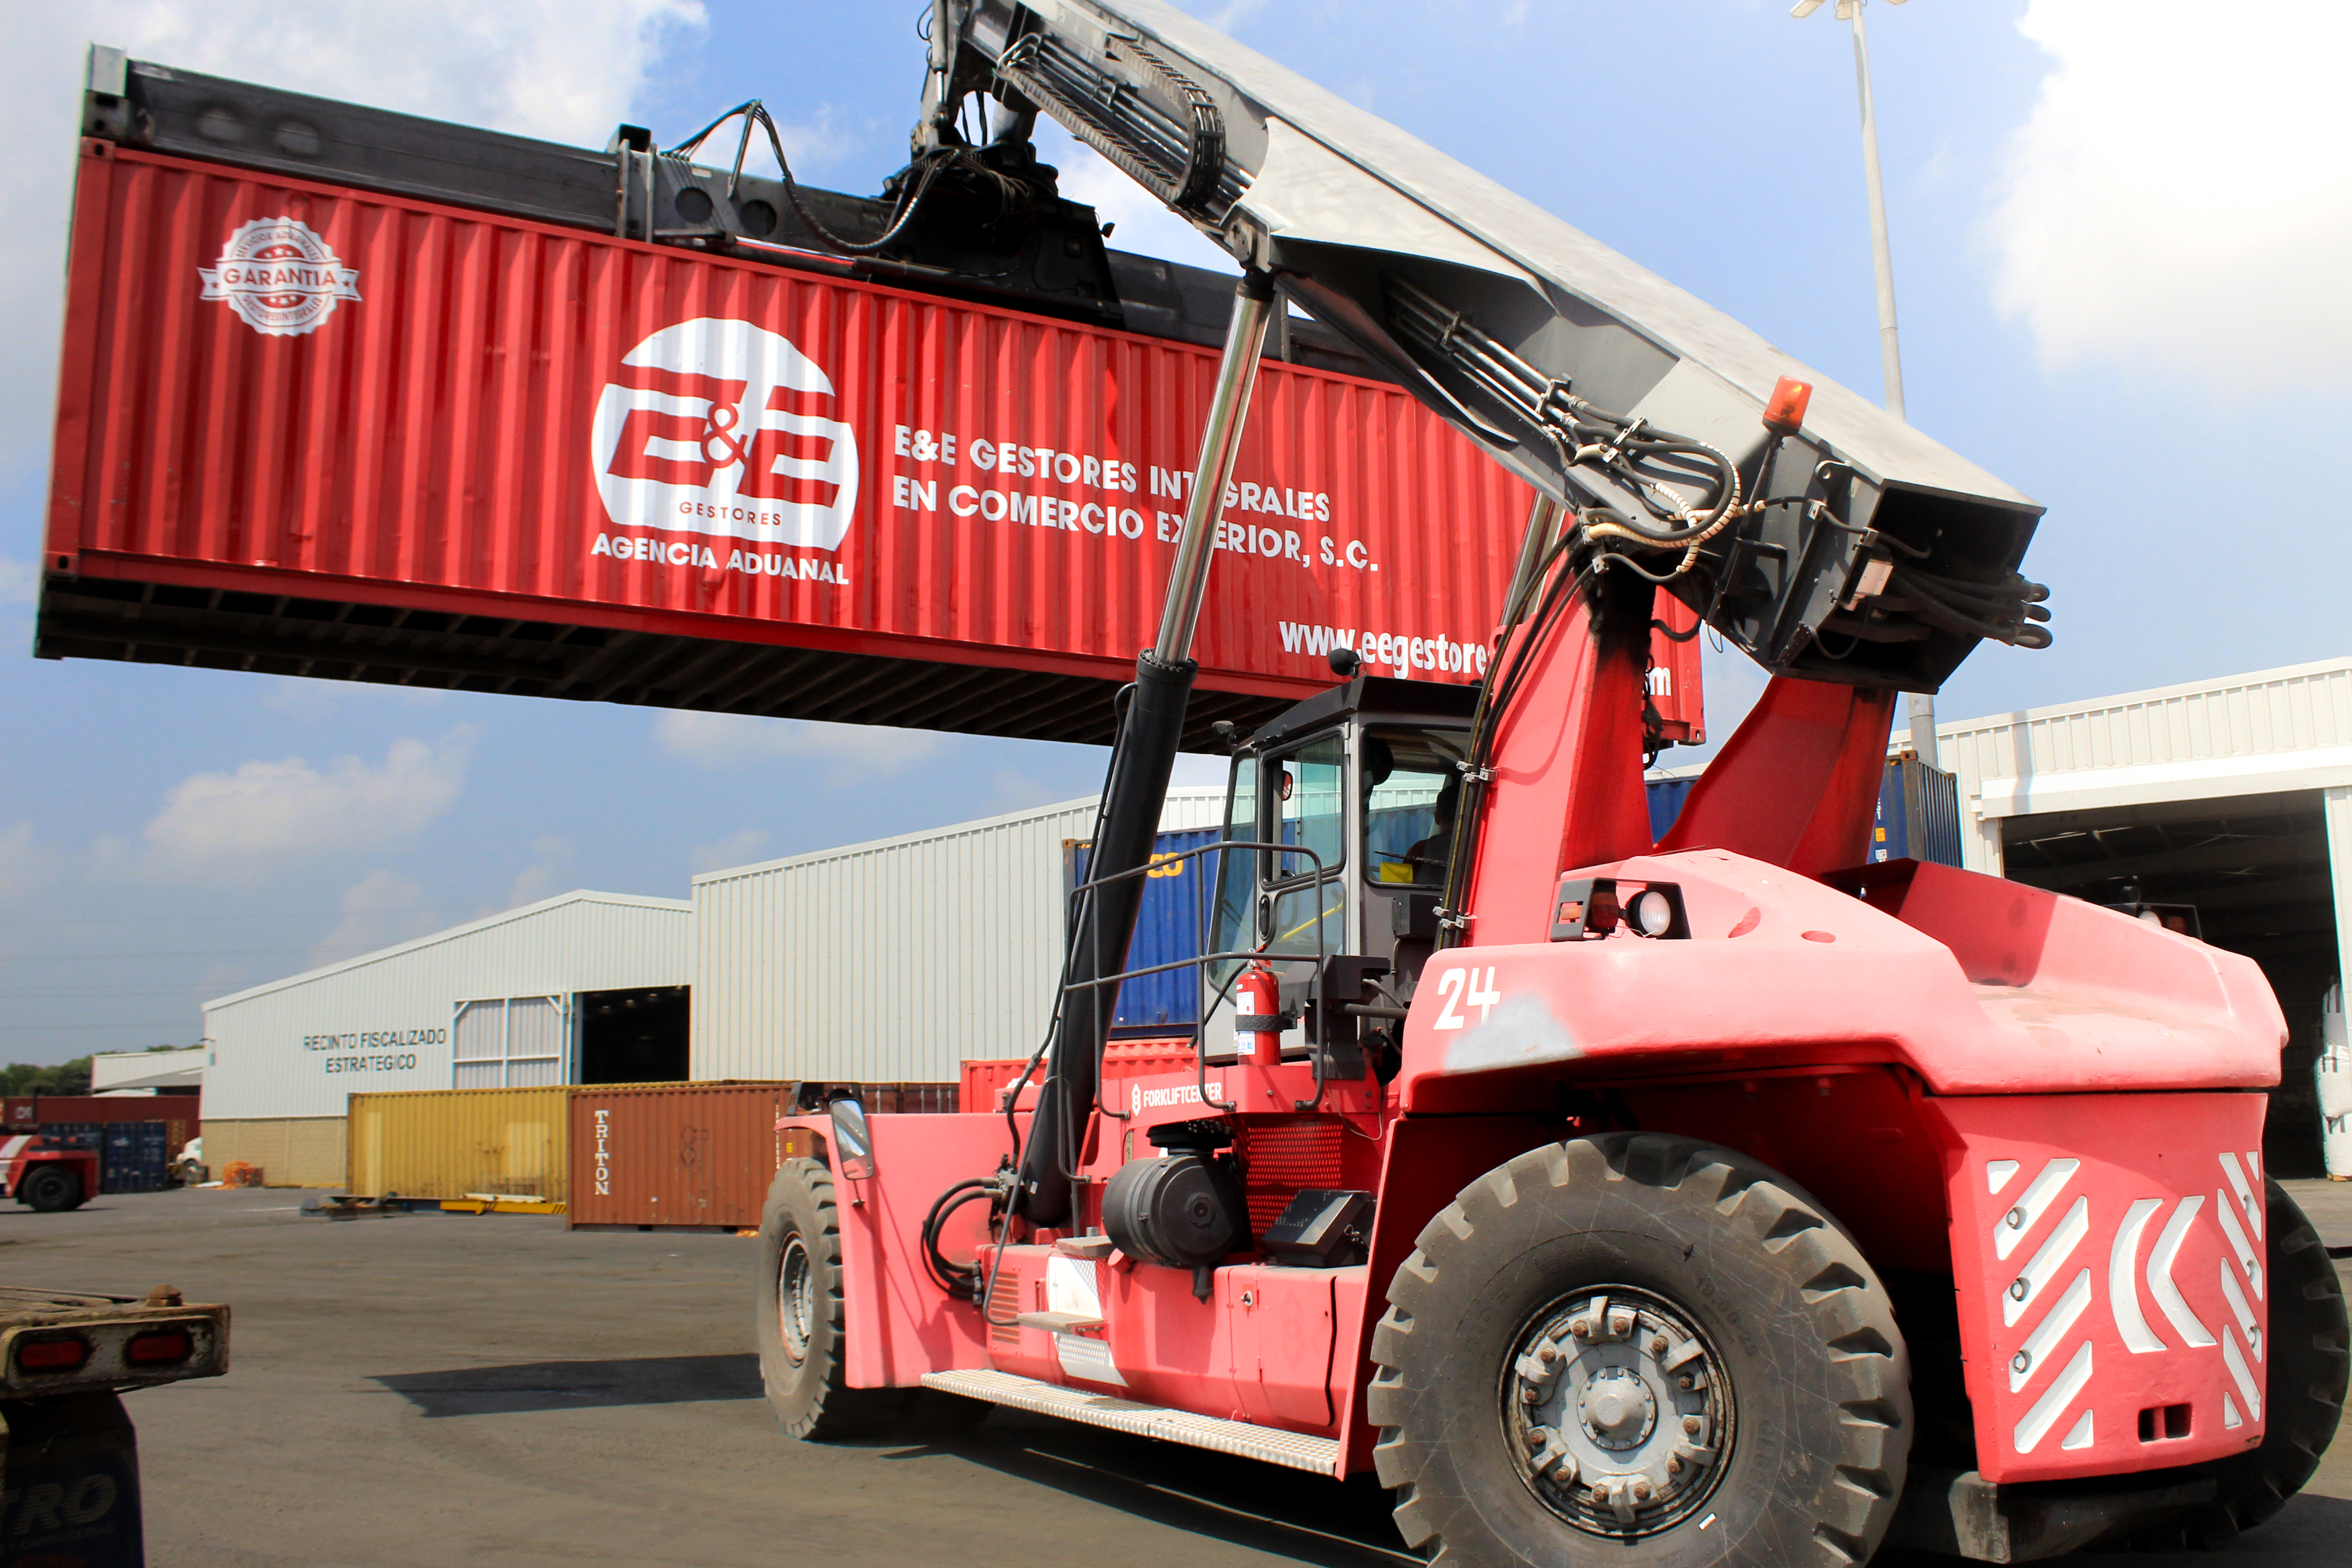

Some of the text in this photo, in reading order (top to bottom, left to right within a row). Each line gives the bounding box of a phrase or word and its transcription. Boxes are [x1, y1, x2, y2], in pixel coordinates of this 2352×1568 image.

[224, 268, 338, 286] GARANTIA
[895, 424, 1330, 522] E&E GESTORES INTGRALES
[679, 501, 781, 525] GESTORES
[893, 475, 1379, 572] EN COMERCIO EXERIOR, S.C.
[590, 533, 849, 585] AGENCIA ADUANAL
[1433, 966, 1500, 1030] 24
[303, 1028, 446, 1051] RECINTO FISCALIZADO
[1143, 1082, 1222, 1107] FORKLIFTCENTER
[595, 1110, 609, 1195] TRITON
